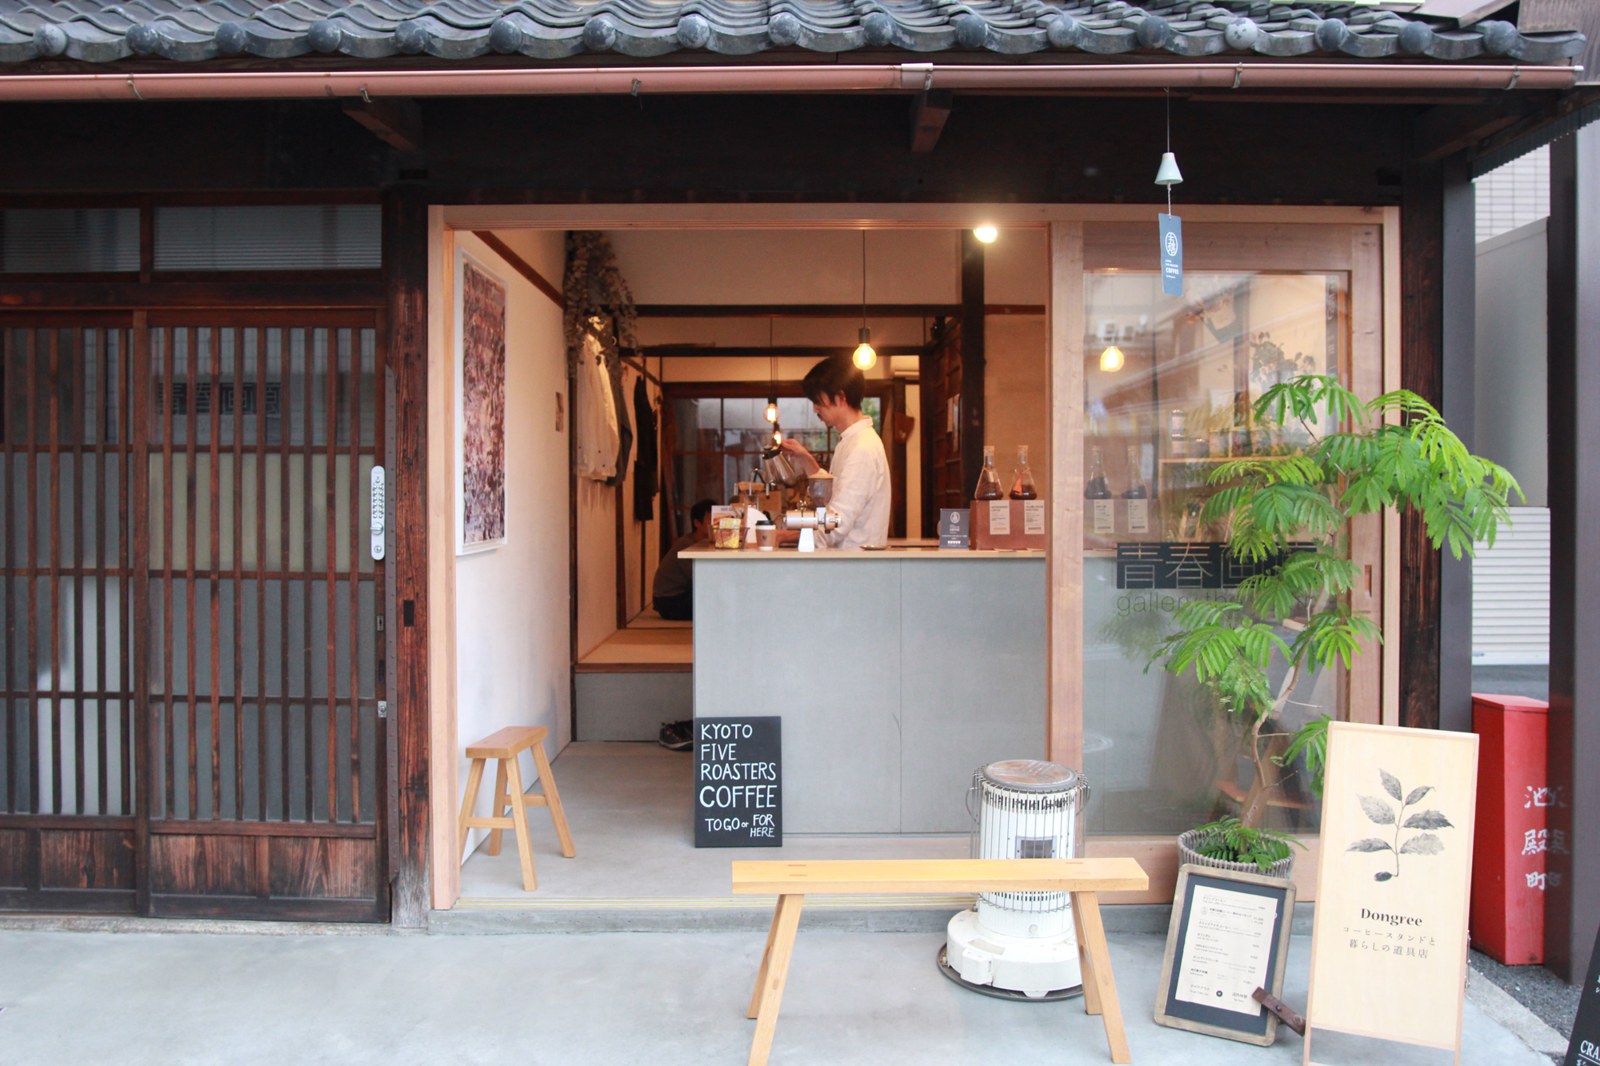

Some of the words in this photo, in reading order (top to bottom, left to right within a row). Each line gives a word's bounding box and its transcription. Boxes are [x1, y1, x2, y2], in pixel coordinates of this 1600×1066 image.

[1117, 542, 1318, 588] 青春画
[701, 723, 753, 740] KYOTO
[701, 743, 737, 761] FIVE
[701, 762, 776, 781] ROASTERS
[699, 785, 778, 808] COFFEE
[753, 814, 775, 827] FOR
[750, 827, 775, 838] HERE
[1361, 907, 1423, 926] Dongree
[1343, 926, 1436, 946] コーヒースタンドと
[1349, 938, 1429, 959] 暮らしの道具店
[1580, 1040, 1600, 1061] CRA
